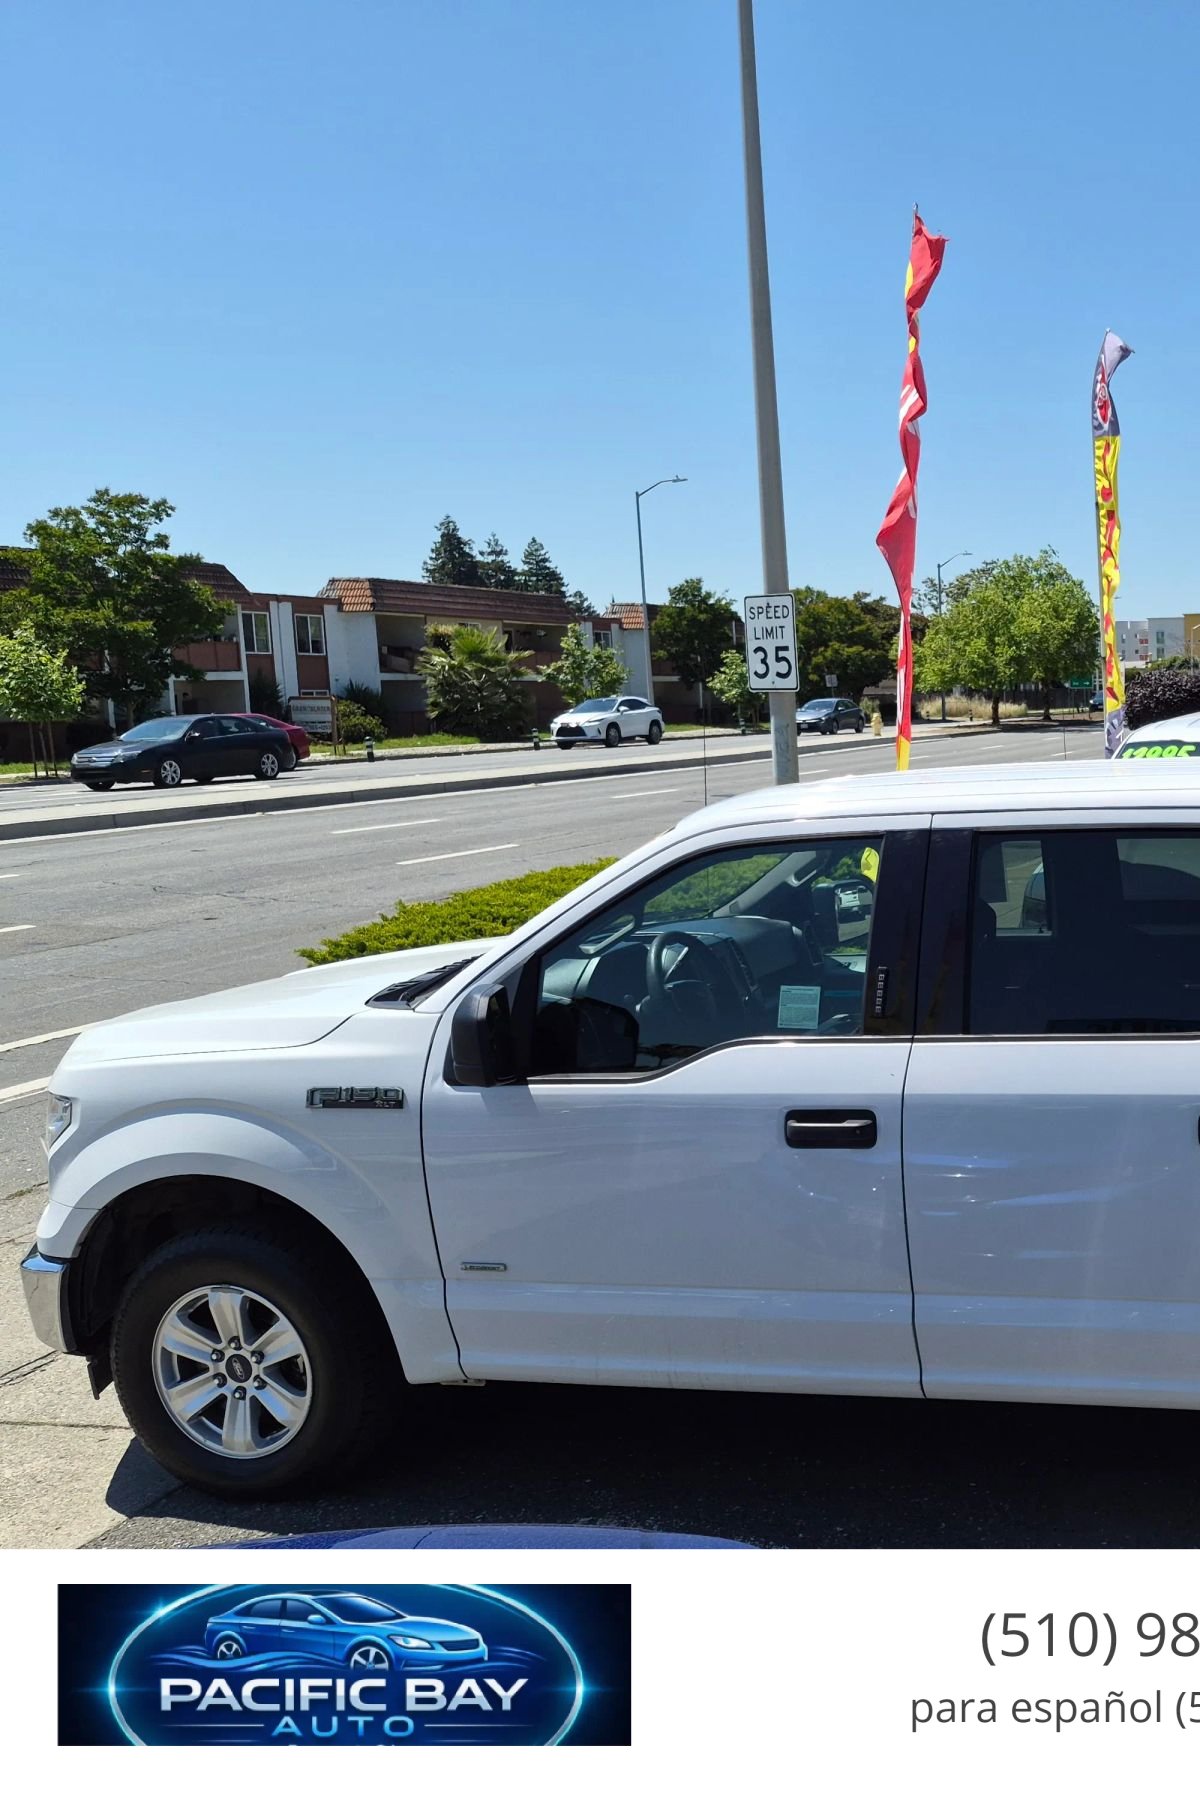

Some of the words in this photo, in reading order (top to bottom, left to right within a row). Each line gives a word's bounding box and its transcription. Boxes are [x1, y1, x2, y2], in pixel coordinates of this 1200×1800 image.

[749, 605, 790, 620] SPEED
[754, 626, 785, 640] LIMIT
[753, 646, 792, 679] 35
